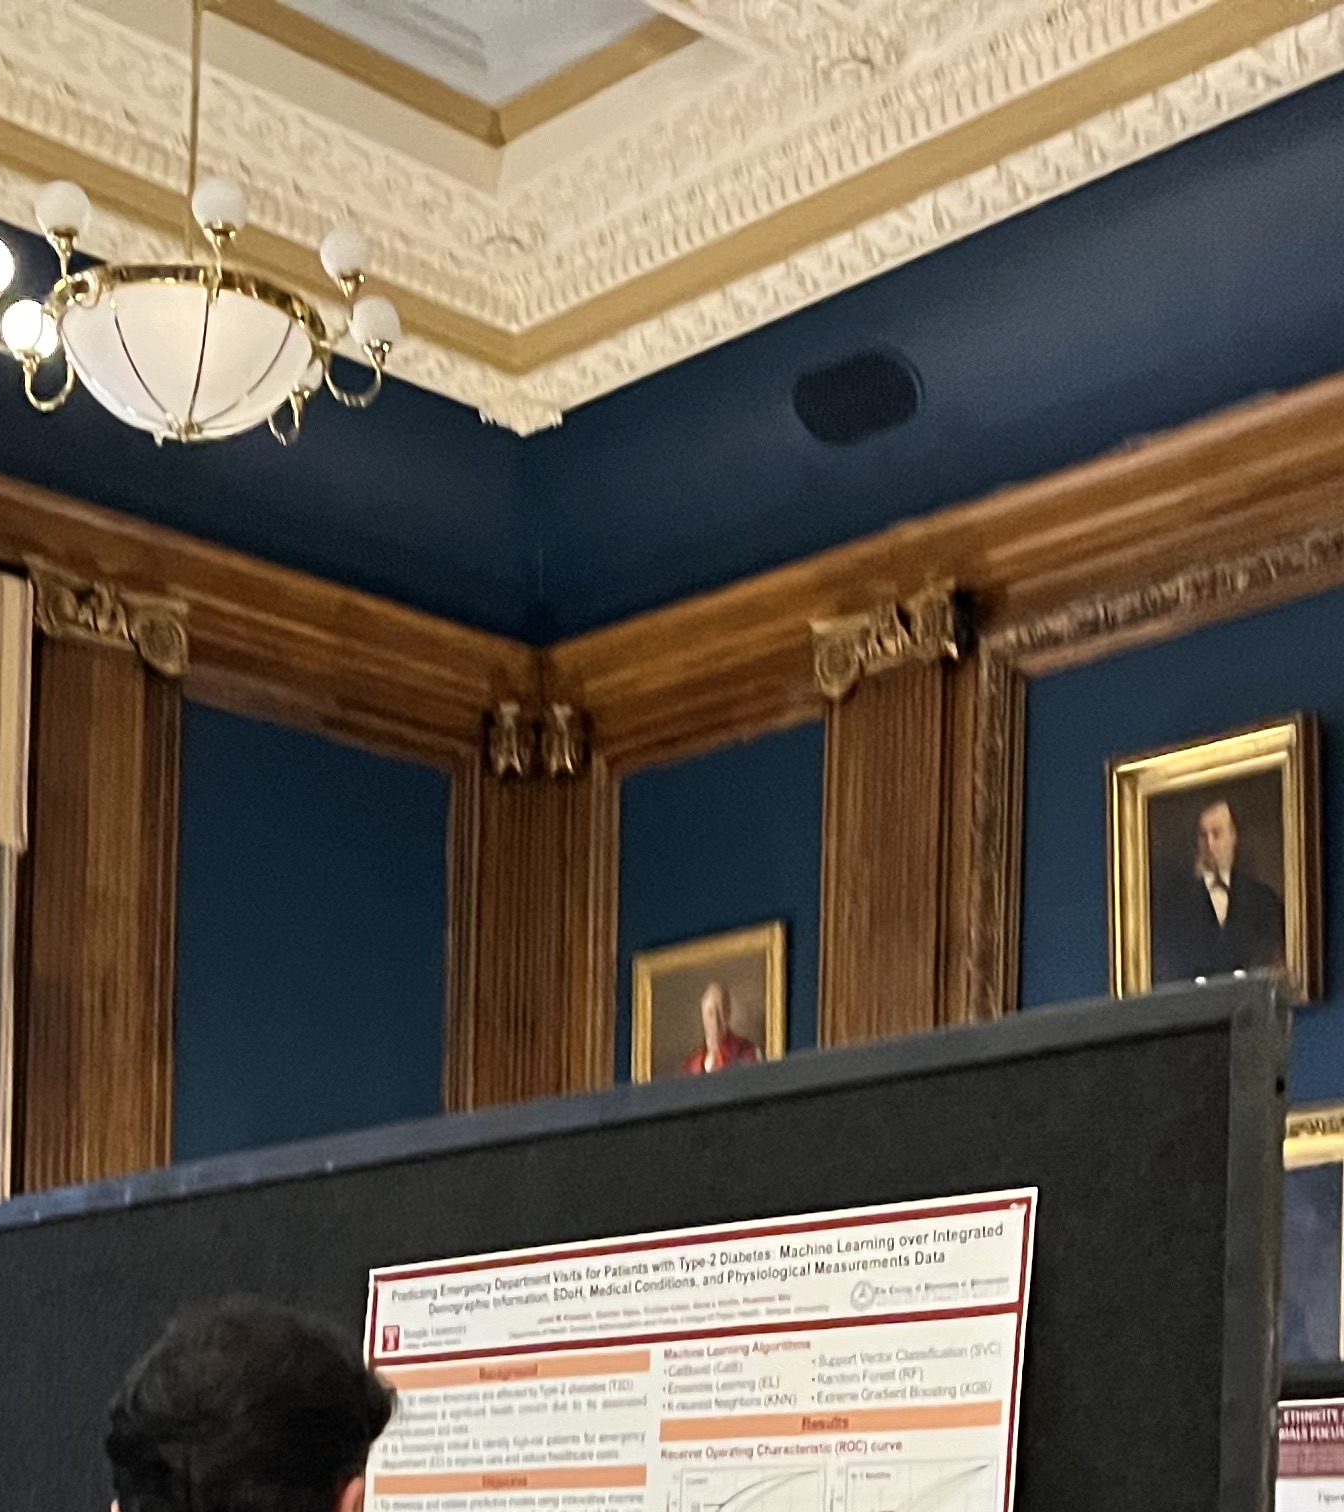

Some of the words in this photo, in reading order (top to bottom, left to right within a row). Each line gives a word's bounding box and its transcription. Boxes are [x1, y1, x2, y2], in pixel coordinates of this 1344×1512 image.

[495, 1273, 550, 1291] Department
[553, 1269, 582, 1283] Visits
[586, 1266, 601, 1279] for
[604, 1262, 649, 1278] Patients
[652, 1260, 675, 1274] with
[679, 1253, 717, 1271] Type-2
[779, 1244, 833, 1259] Machine
[837, 1236, 895, 1254] Learning
[899, 1234, 929, 1247] over
[933, 1224, 1004, 1243] Integrated
[590, 1281, 632, 1298] Medical
[703, 1271, 724, 1287] and
[727, 1264, 811, 1285] Physiological
[815, 1255, 910, 1275] Measurements
[914, 1250, 946, 1266] Data
[801, 1416, 849, 1432] Results
[835, 1438, 868, 1455] (ROC)
[871, 1440, 903, 1452] curve
